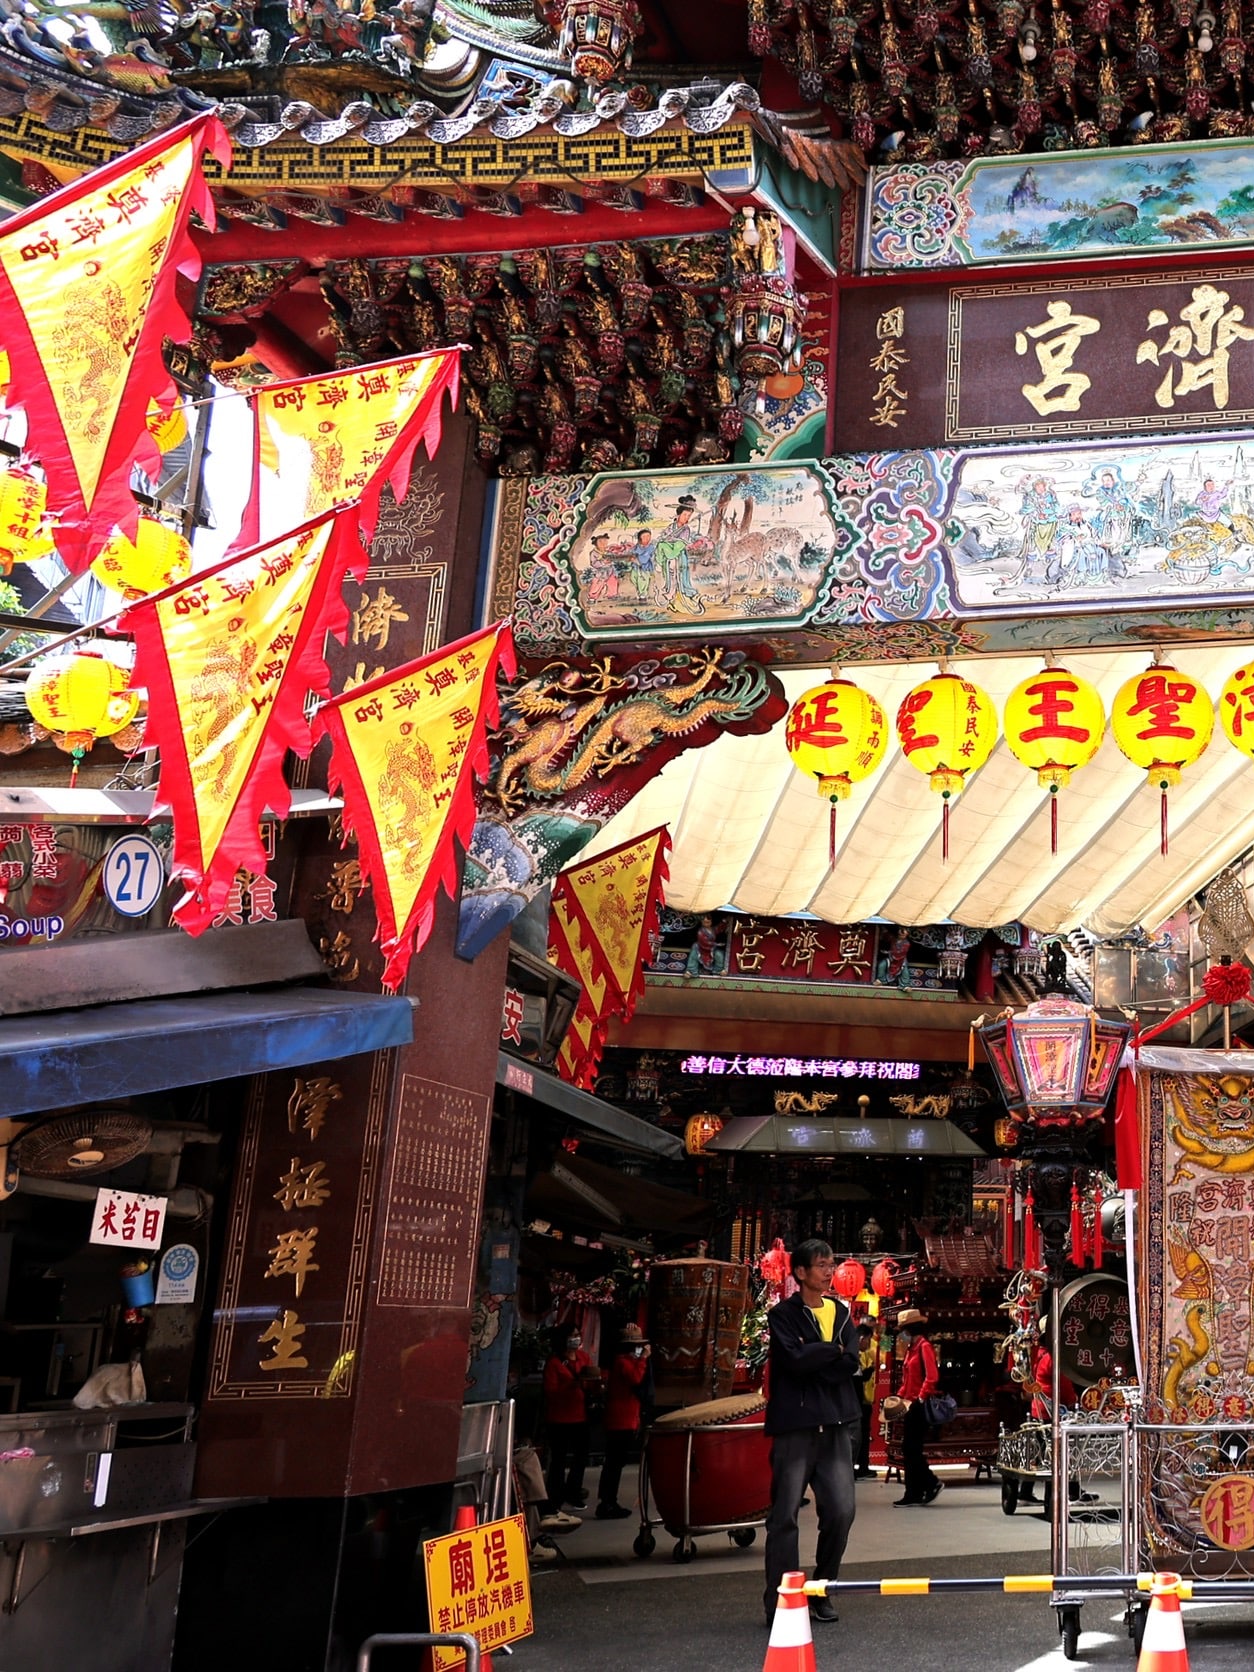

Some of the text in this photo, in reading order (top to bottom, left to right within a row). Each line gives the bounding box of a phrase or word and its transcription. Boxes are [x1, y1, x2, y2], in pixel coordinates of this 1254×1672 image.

[20, 185, 149, 262] 奠濟宮
[273, 372, 391, 412] 奠濟宮
[869, 306, 911, 429] 國泰民安
[173, 551, 294, 616] 奠濟宮
[354, 667, 459, 723] 奠濟宮
[958, 682, 982, 758] 國泰民安
[1018, 680, 1090, 743] 王
[1126, 675, 1197, 740] 聖
[433, 705, 475, 809] 開漳聖王
[116, 851, 150, 903] 27
[576, 852, 637, 887] 奠濟宮
[0, 914, 64, 942] Soup
[733, 918, 872, 976] 奠濟宮
[98, 1199, 161, 1242] 米苔目
[1168, 1191, 1196, 1223] 隆
[1190, 1217, 1217, 1248] 祝
[448, 1528, 510, 1599] 廟埕
[437, 1579, 526, 1633] 禁止停放汽機車
